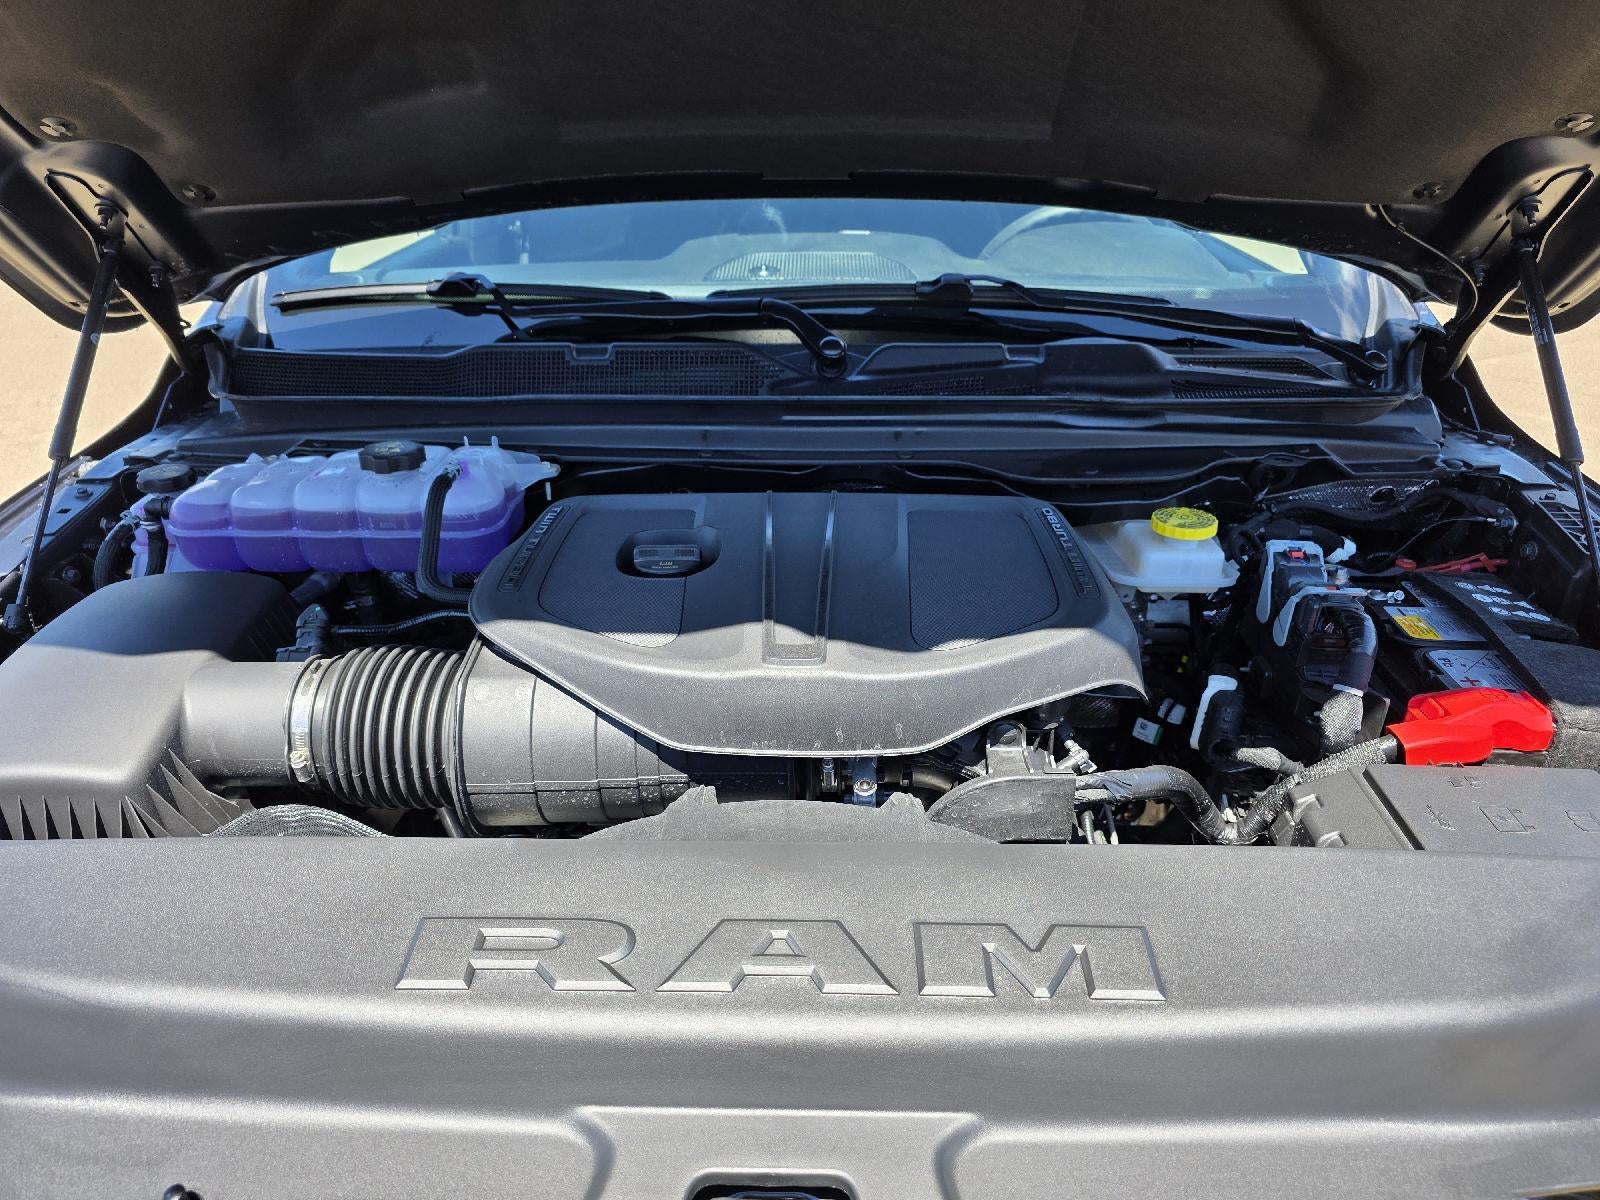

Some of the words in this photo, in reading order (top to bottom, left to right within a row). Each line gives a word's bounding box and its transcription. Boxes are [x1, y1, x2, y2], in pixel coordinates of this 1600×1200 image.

[535, 505, 563, 533] TWIN
[1041, 507, 1073, 551] TURBO
[395, 917, 1166, 1001] RAM
